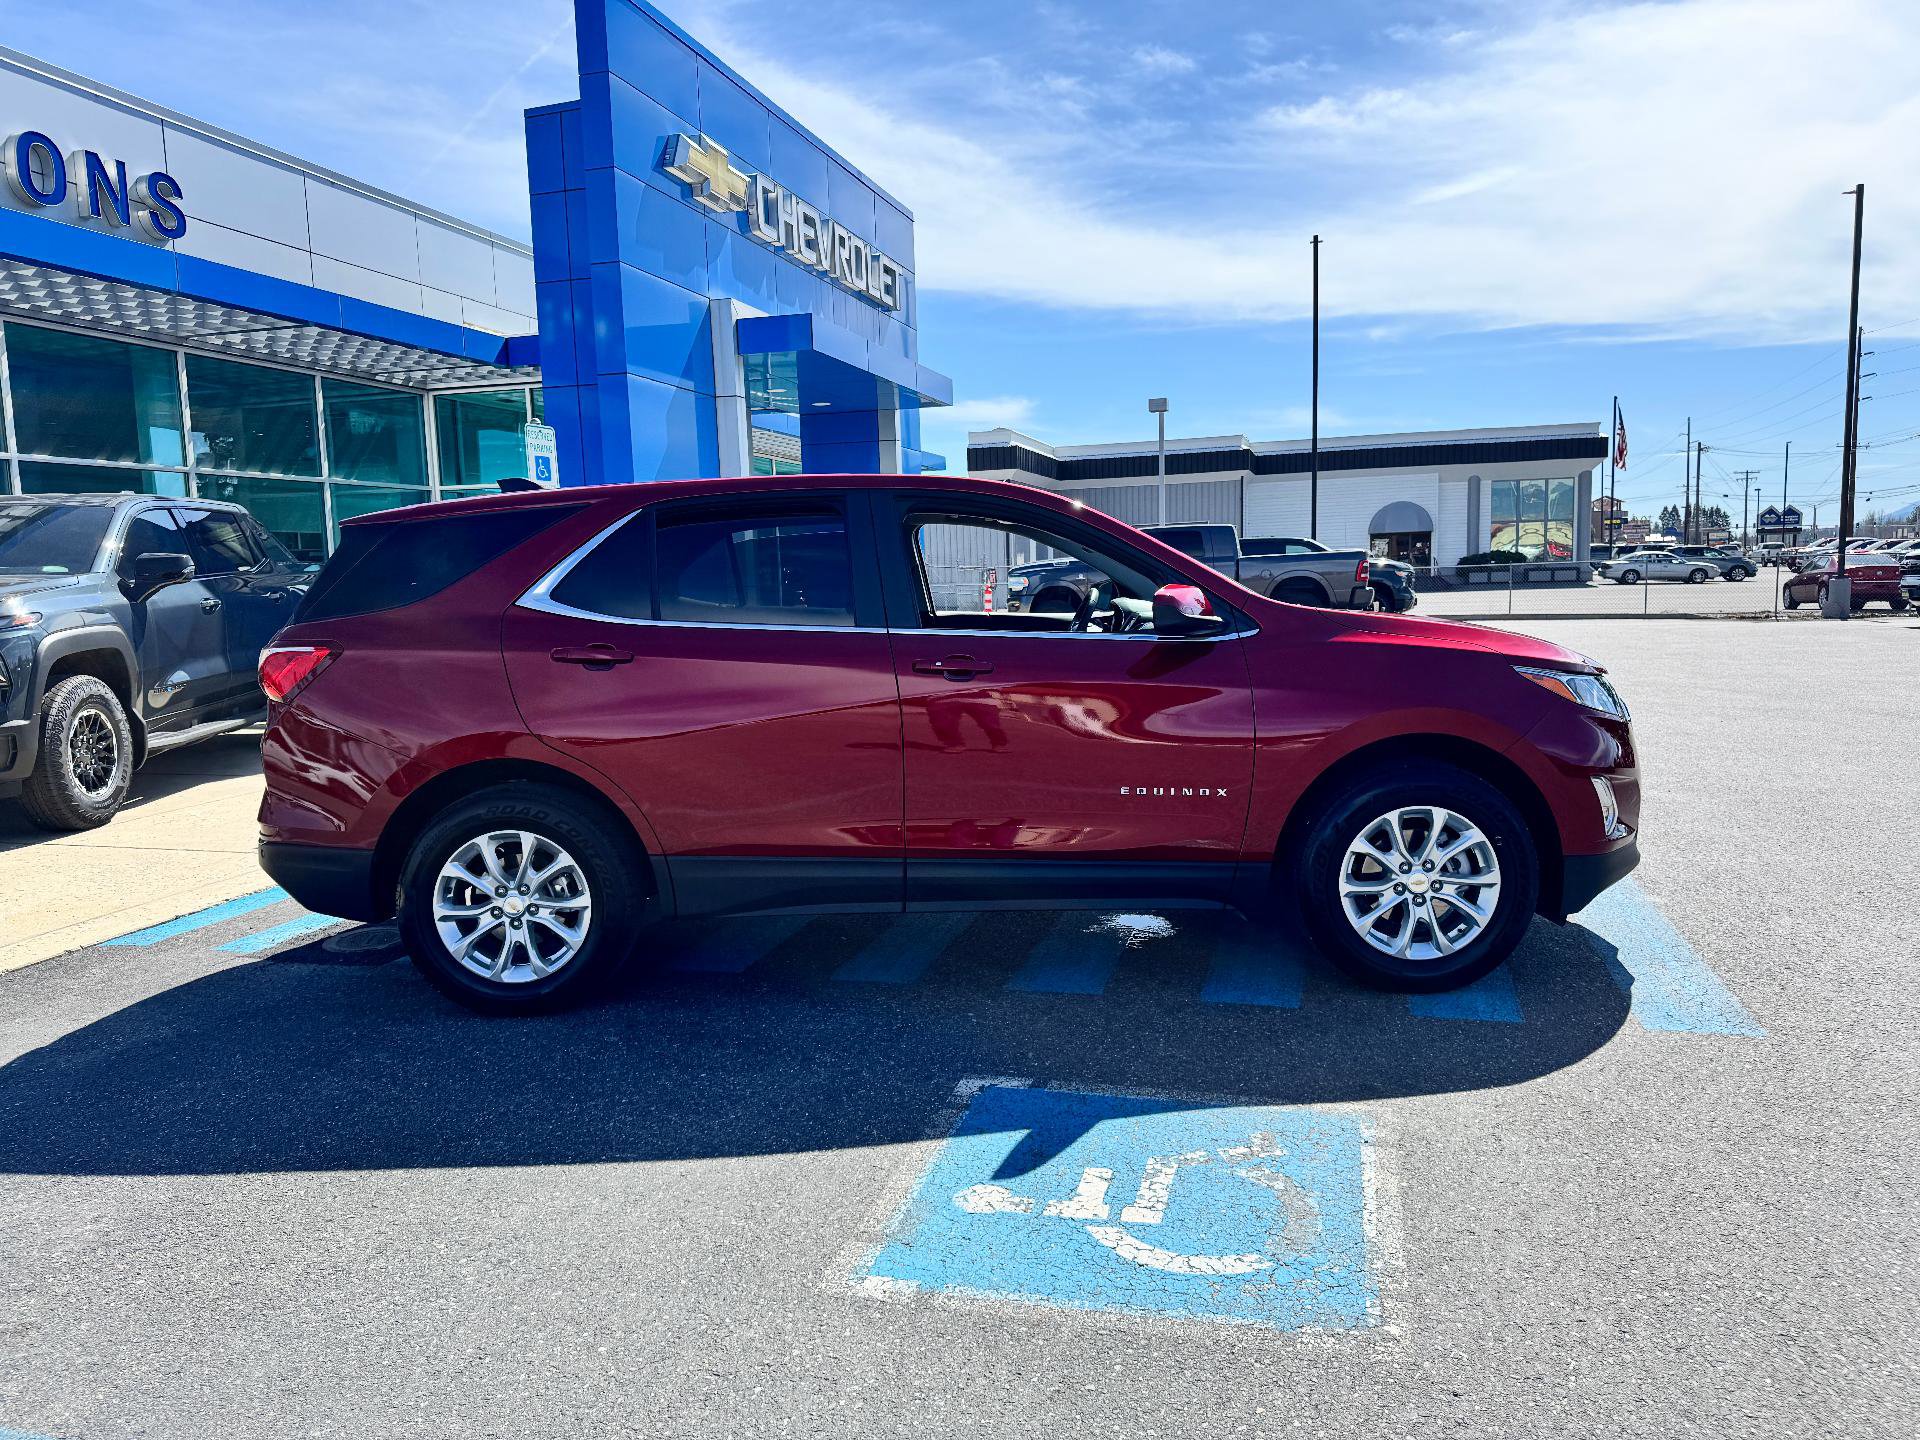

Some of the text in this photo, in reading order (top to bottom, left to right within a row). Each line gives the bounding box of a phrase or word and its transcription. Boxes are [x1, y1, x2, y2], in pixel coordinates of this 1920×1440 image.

[4, 131, 187, 241] ONS
[750, 173, 904, 311] CHEVROLET
[529, 442, 553, 453] PARKING
[1120, 786, 1228, 797] EQUINOX
[485, 804, 551, 820] ROAD
